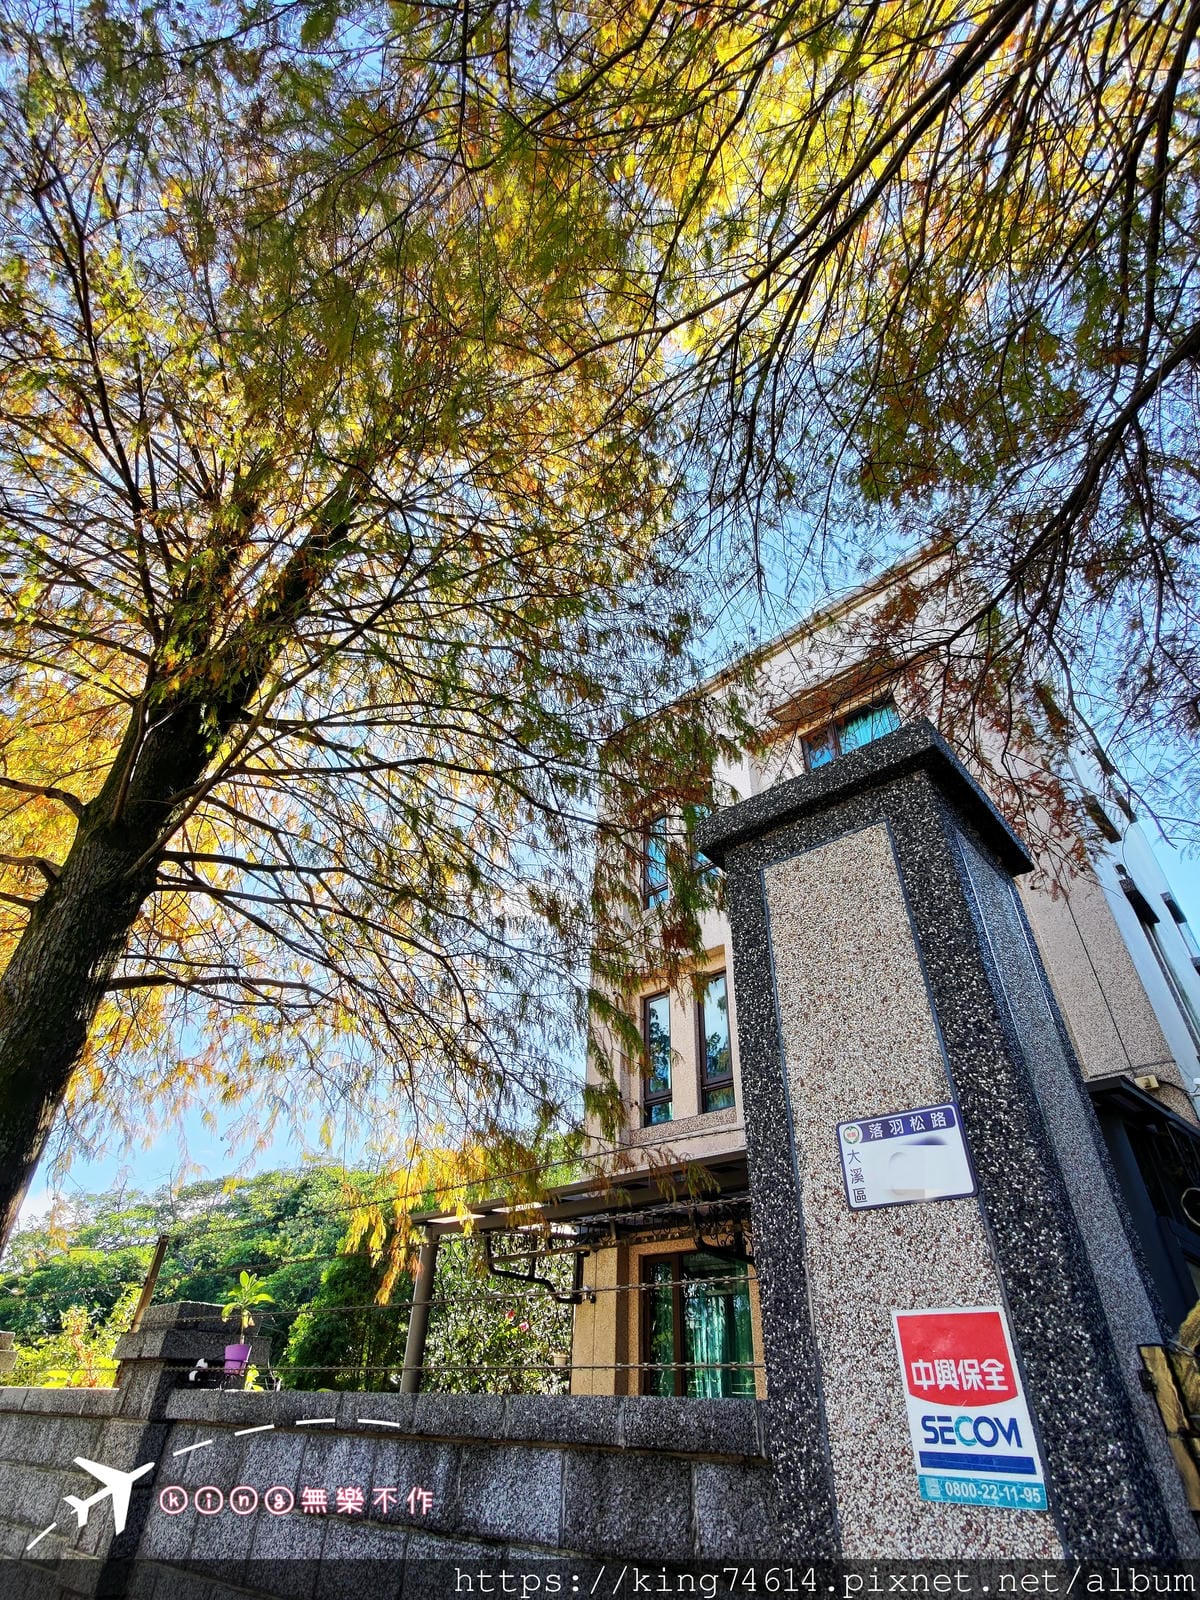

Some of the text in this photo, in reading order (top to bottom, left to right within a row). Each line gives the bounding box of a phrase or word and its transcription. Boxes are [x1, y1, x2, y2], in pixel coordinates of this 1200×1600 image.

[868, 1111, 947, 1139] 落羽松路
[847, 1149, 868, 1204] 大溪區
[910, 1358, 1009, 1391] 中興保全
[921, 1415, 1023, 1449] SECOM
[945, 1481, 1041, 1503] 0800-22-11-95
